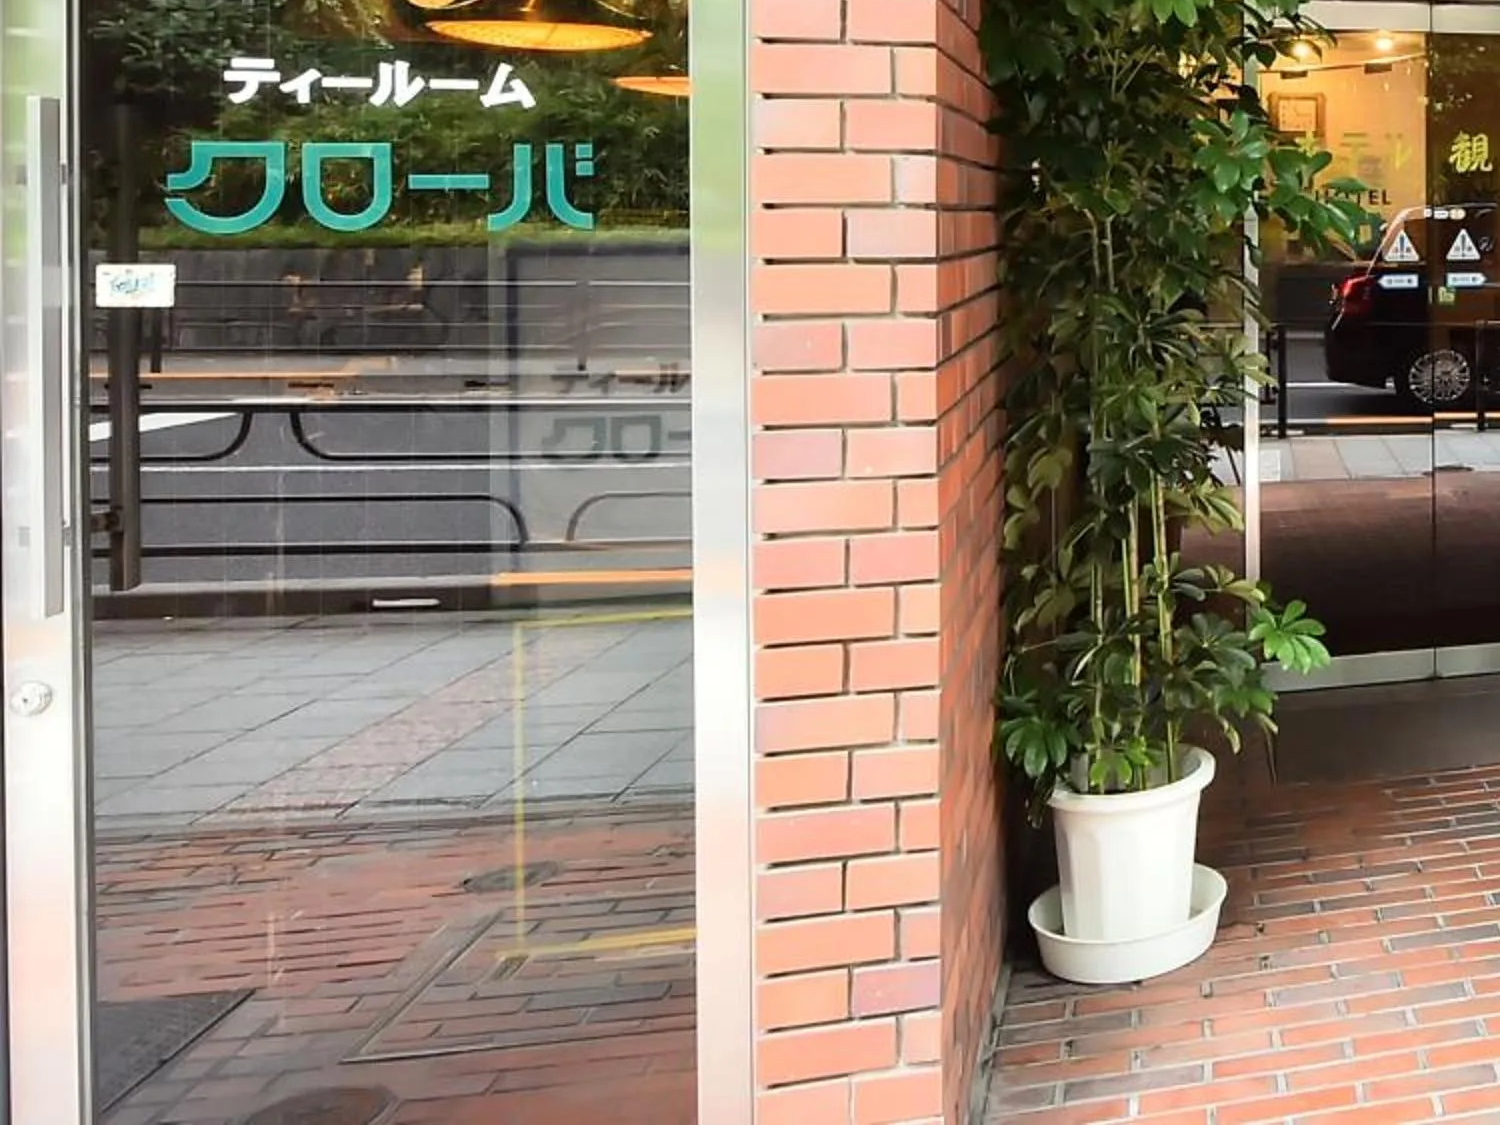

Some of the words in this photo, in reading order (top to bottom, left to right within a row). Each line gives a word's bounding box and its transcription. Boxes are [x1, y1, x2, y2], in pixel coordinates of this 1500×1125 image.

[222, 58, 537, 109] ティールーム
[164, 141, 595, 232] クローバ
